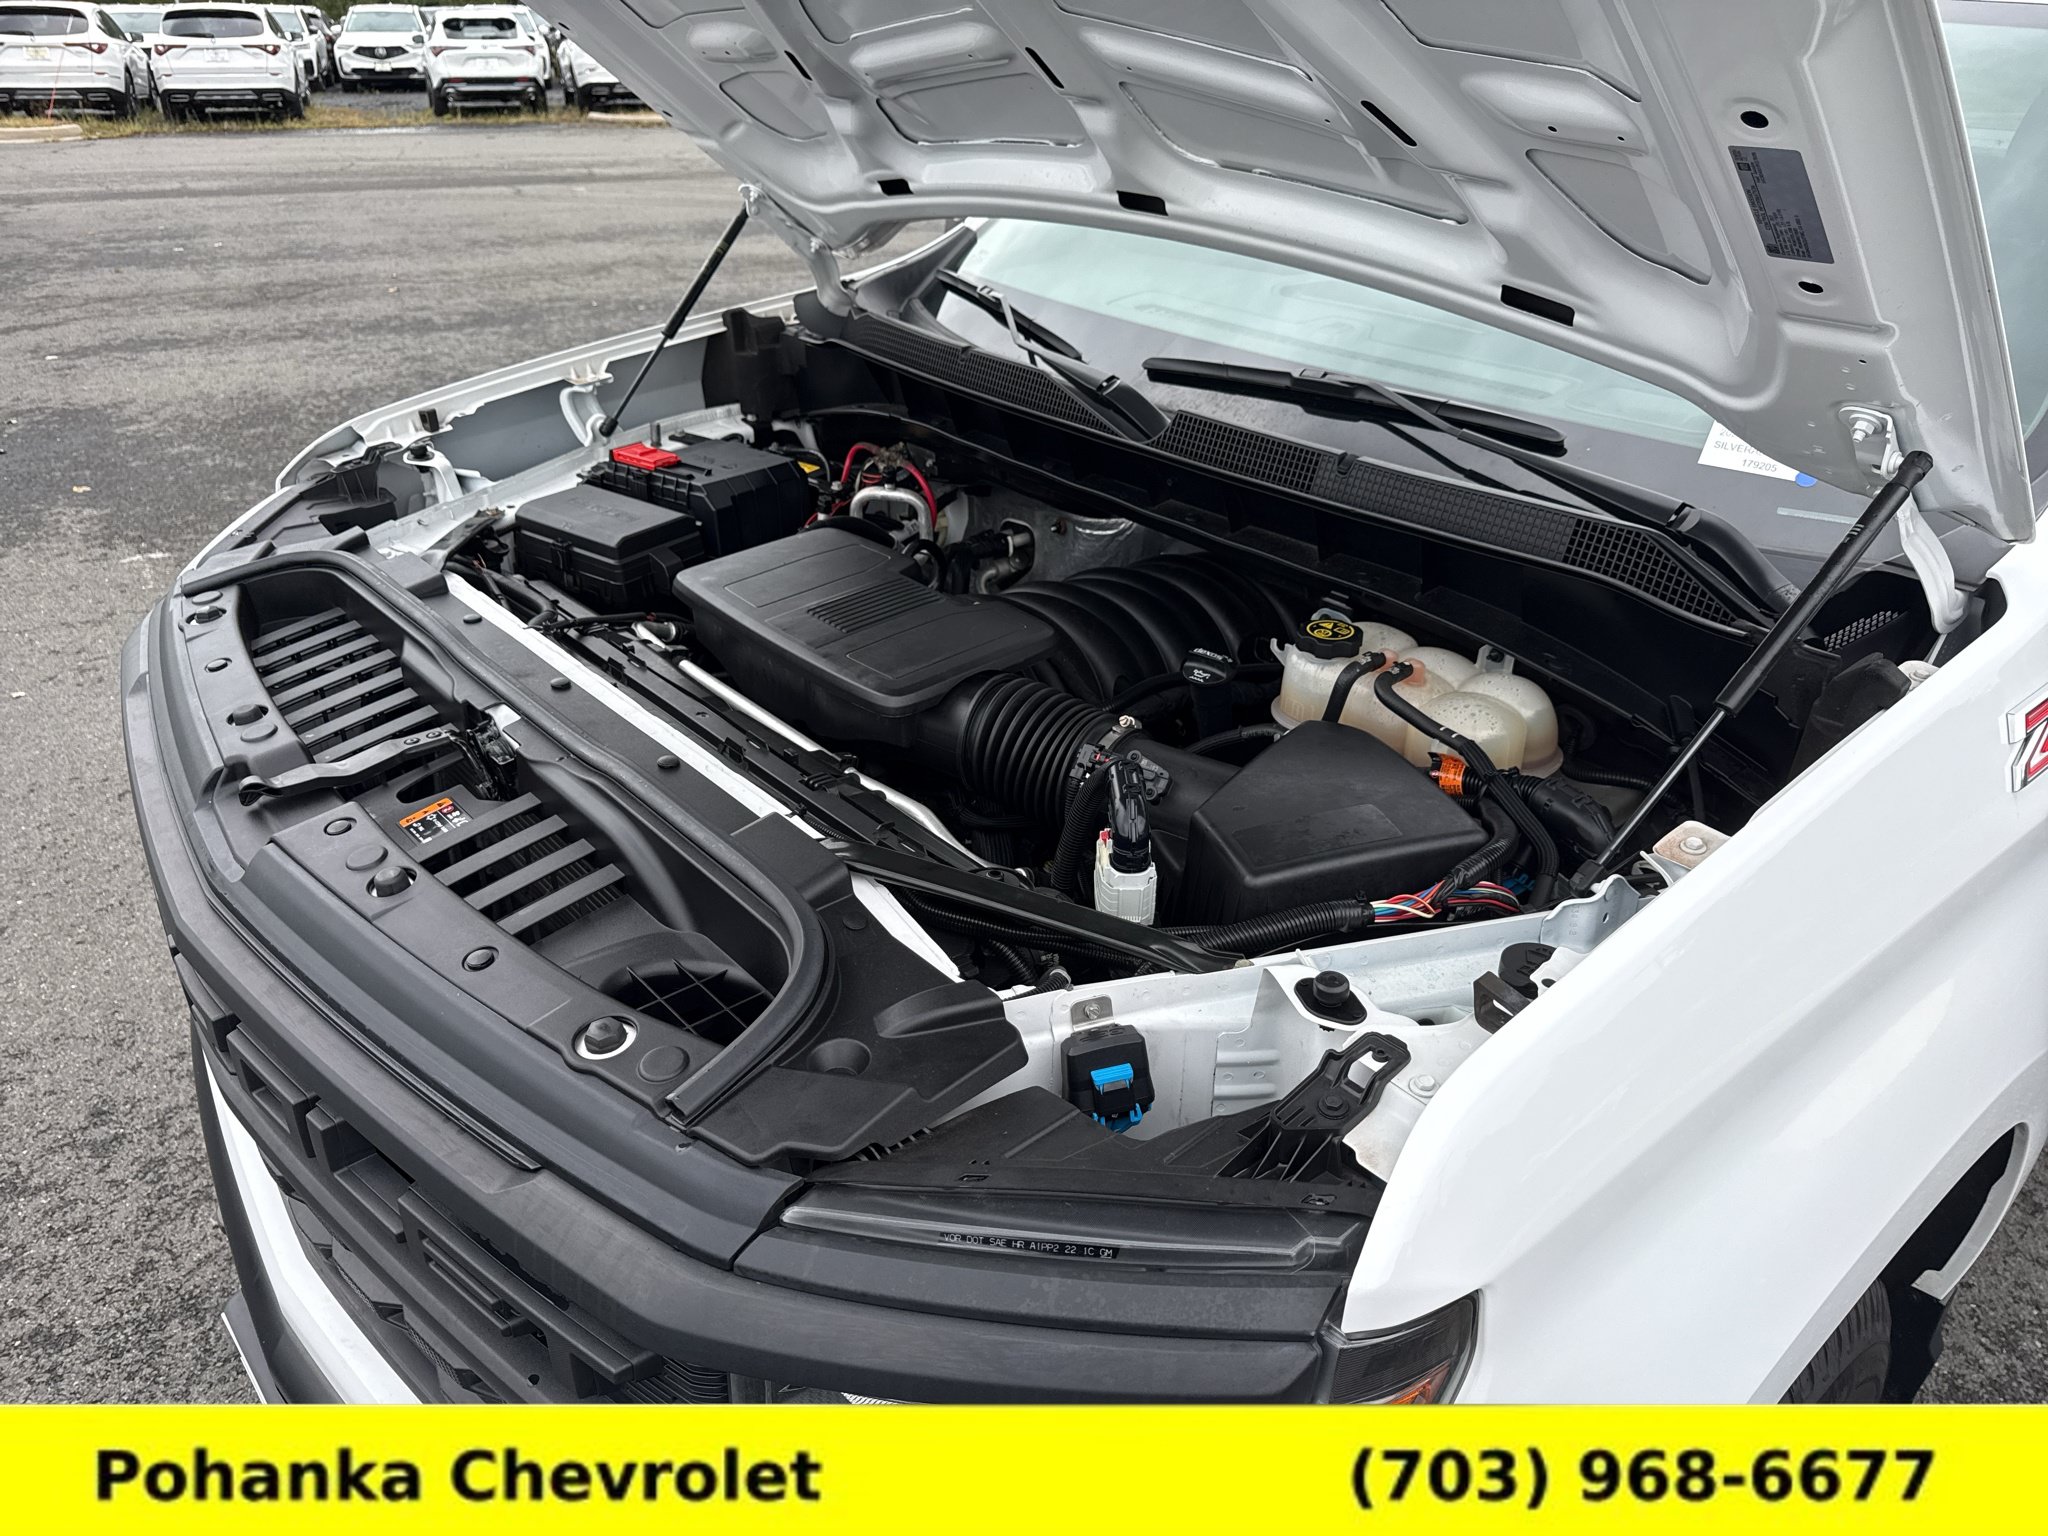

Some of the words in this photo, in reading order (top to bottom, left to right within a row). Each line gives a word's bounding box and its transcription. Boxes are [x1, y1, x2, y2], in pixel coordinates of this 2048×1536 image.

[1742, 459, 1777, 473] 179205
[943, 1233, 962, 1242] VOR
[966, 1235, 984, 1245] DOT
[989, 1237, 1007, 1248] SAE
[1012, 1240, 1025, 1249] HR
[1064, 1244, 1077, 1254] 22
[1099, 1248, 1113, 1259] GM
